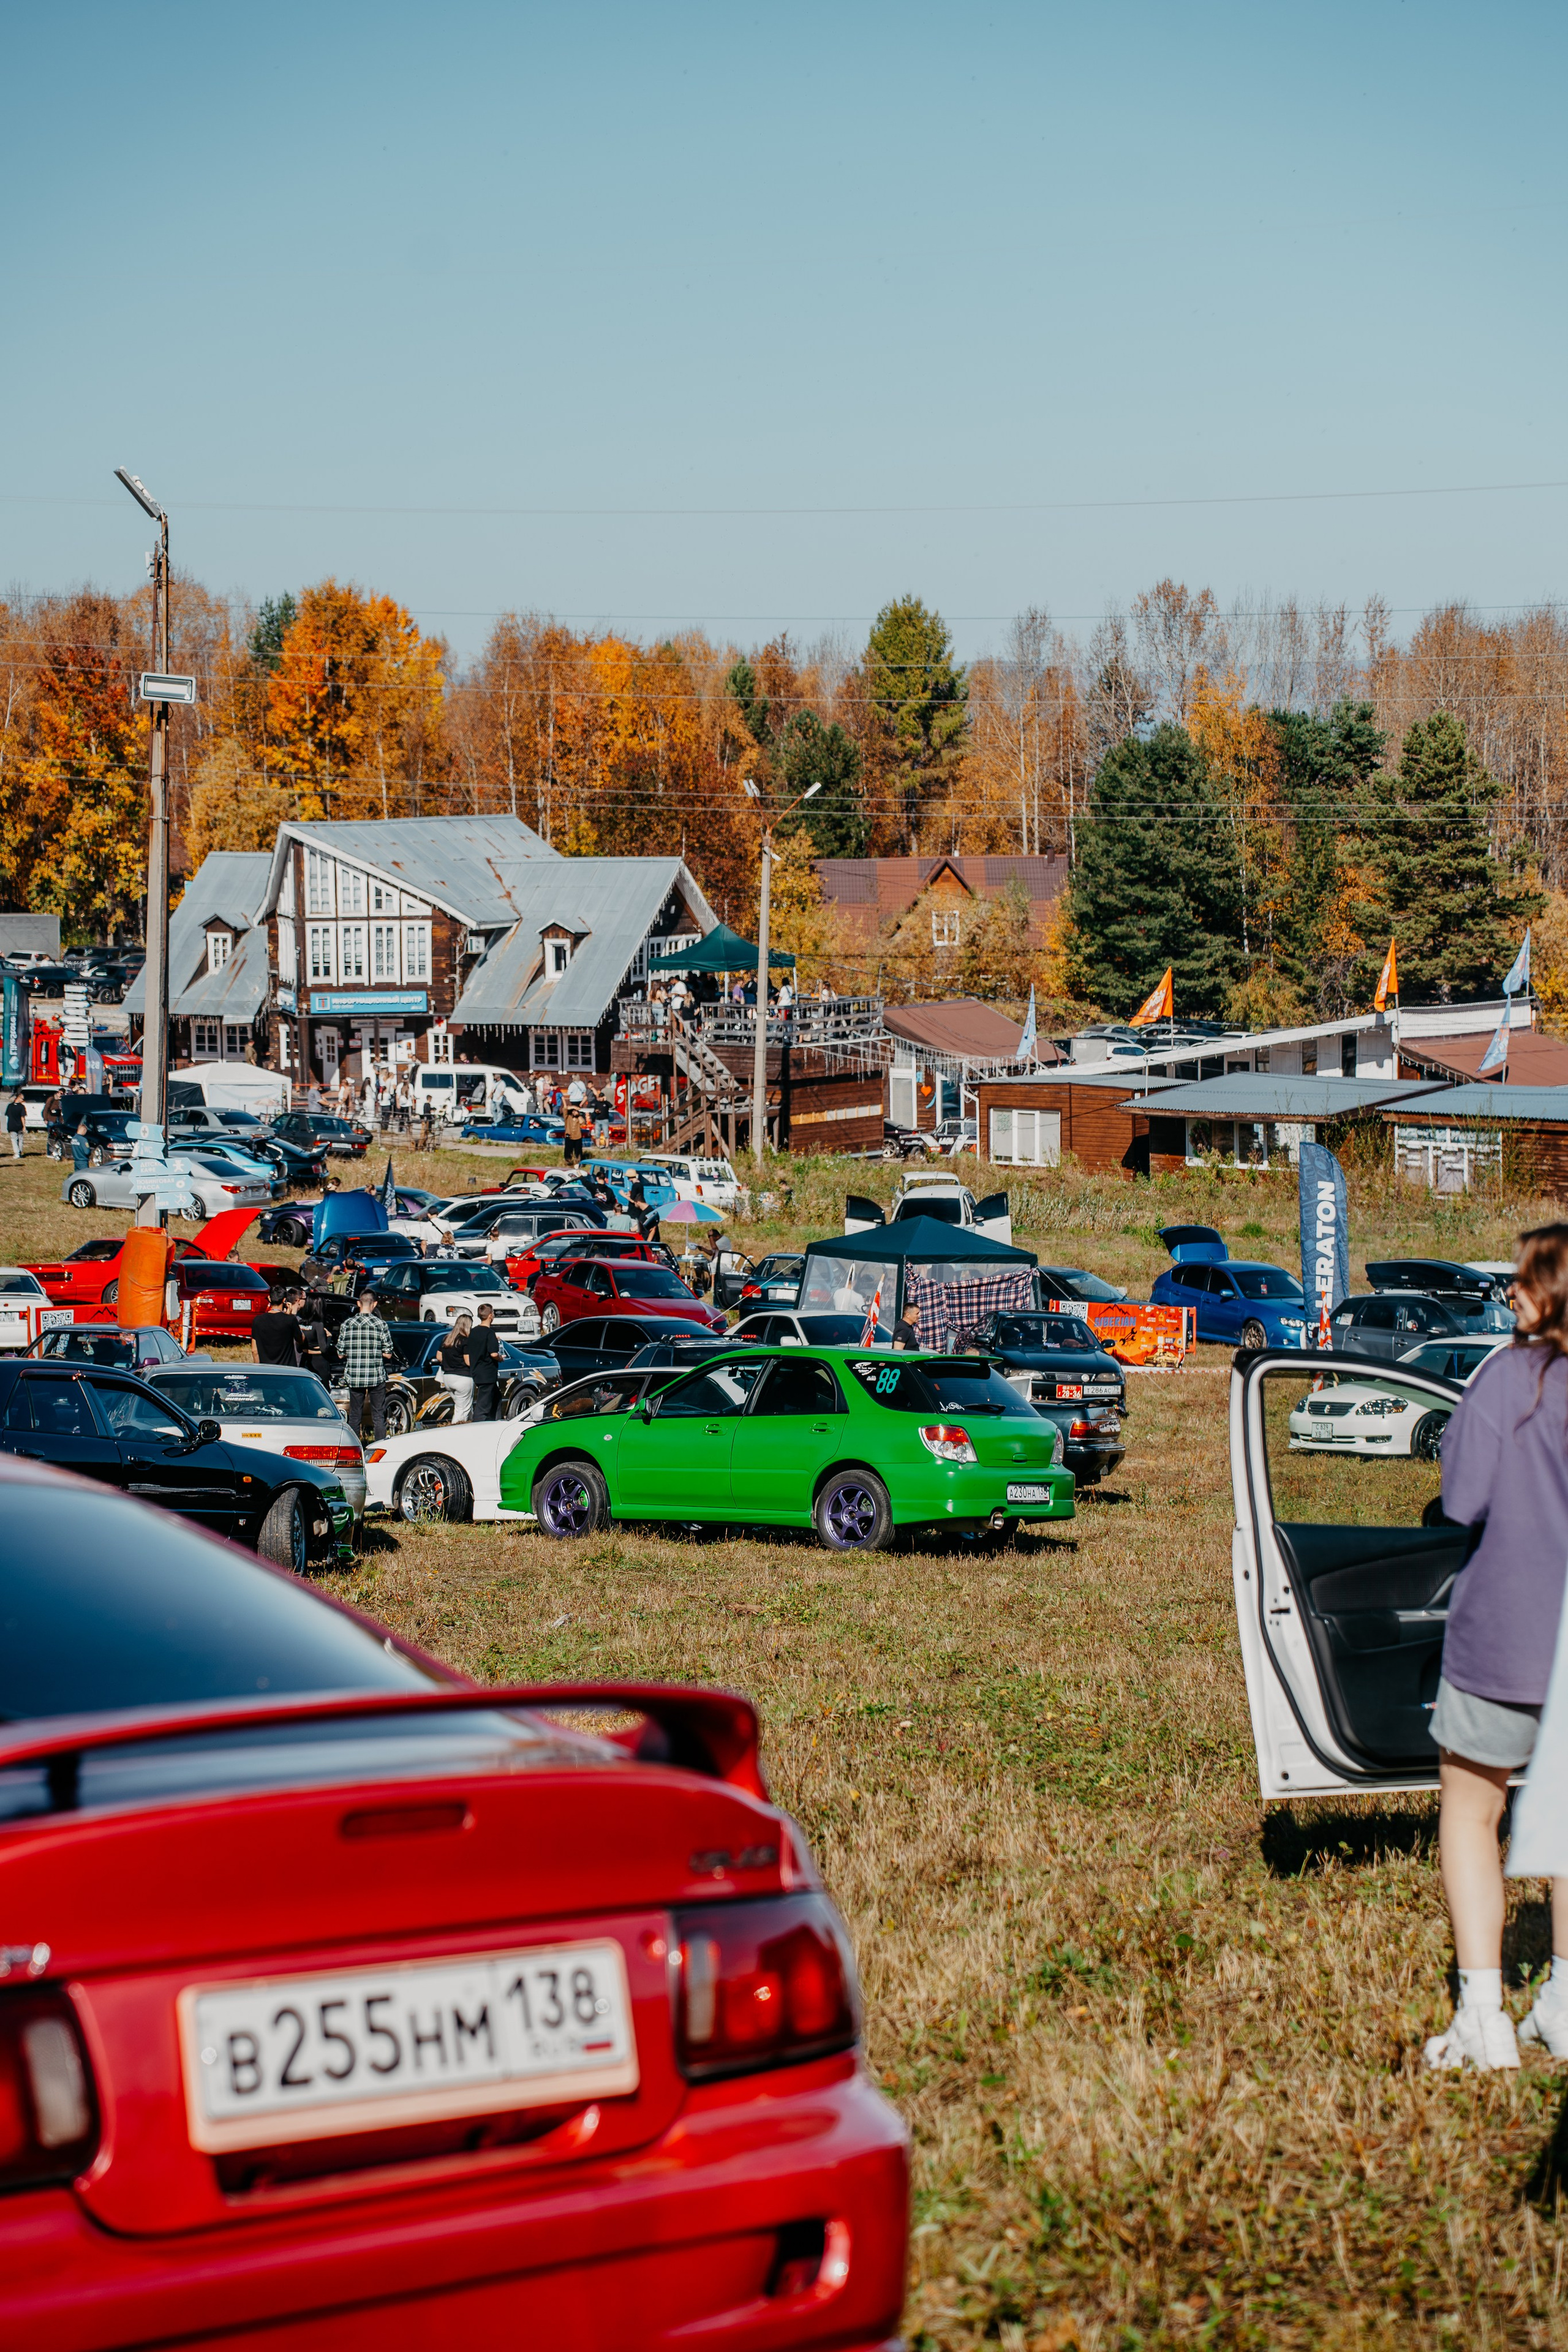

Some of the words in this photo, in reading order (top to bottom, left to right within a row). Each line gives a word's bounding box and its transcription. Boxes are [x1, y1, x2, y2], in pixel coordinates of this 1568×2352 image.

[400, 995, 423, 1005] ЦЕНТР
[617, 1075, 661, 1104] SAGE+
[1094, 1316, 1137, 1327] SIBERIAN
[1100, 1327, 1126, 1336] EXPO
[876, 1368, 900, 1393] 88
[1009, 1487, 1036, 1498] А230НА
[227, 1994, 497, 2096] В255НМ
[506, 1967, 598, 2031] 138
